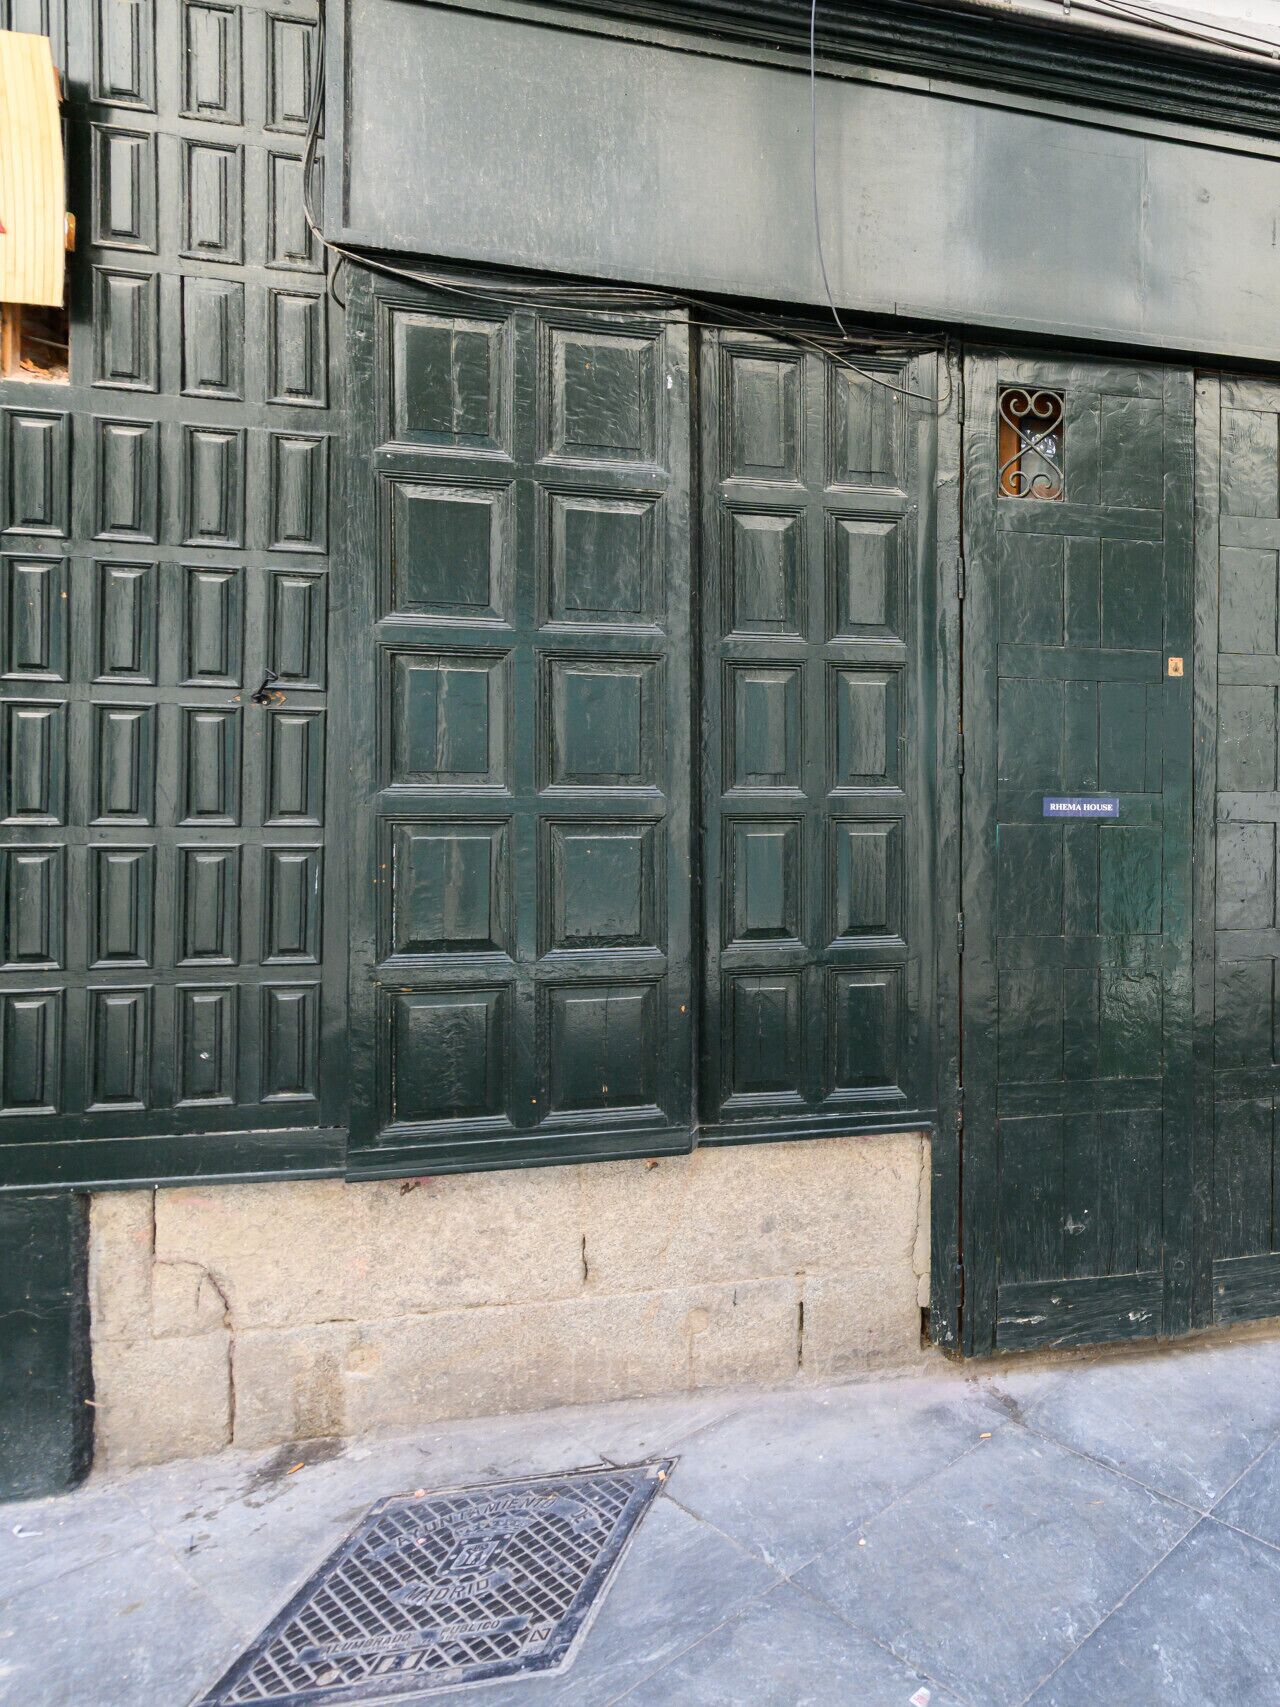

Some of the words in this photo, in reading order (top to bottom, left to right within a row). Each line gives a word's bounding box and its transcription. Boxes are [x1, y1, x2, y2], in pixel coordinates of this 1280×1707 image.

[1050, 803, 1081, 811] RHEMA
[1083, 803, 1113, 811] HOUSE
[397, 1496, 556, 1547] AYUNTAMIENTO
[404, 1579, 490, 1602] MADRID
[325, 1632, 411, 1654] ALUMBRADO
